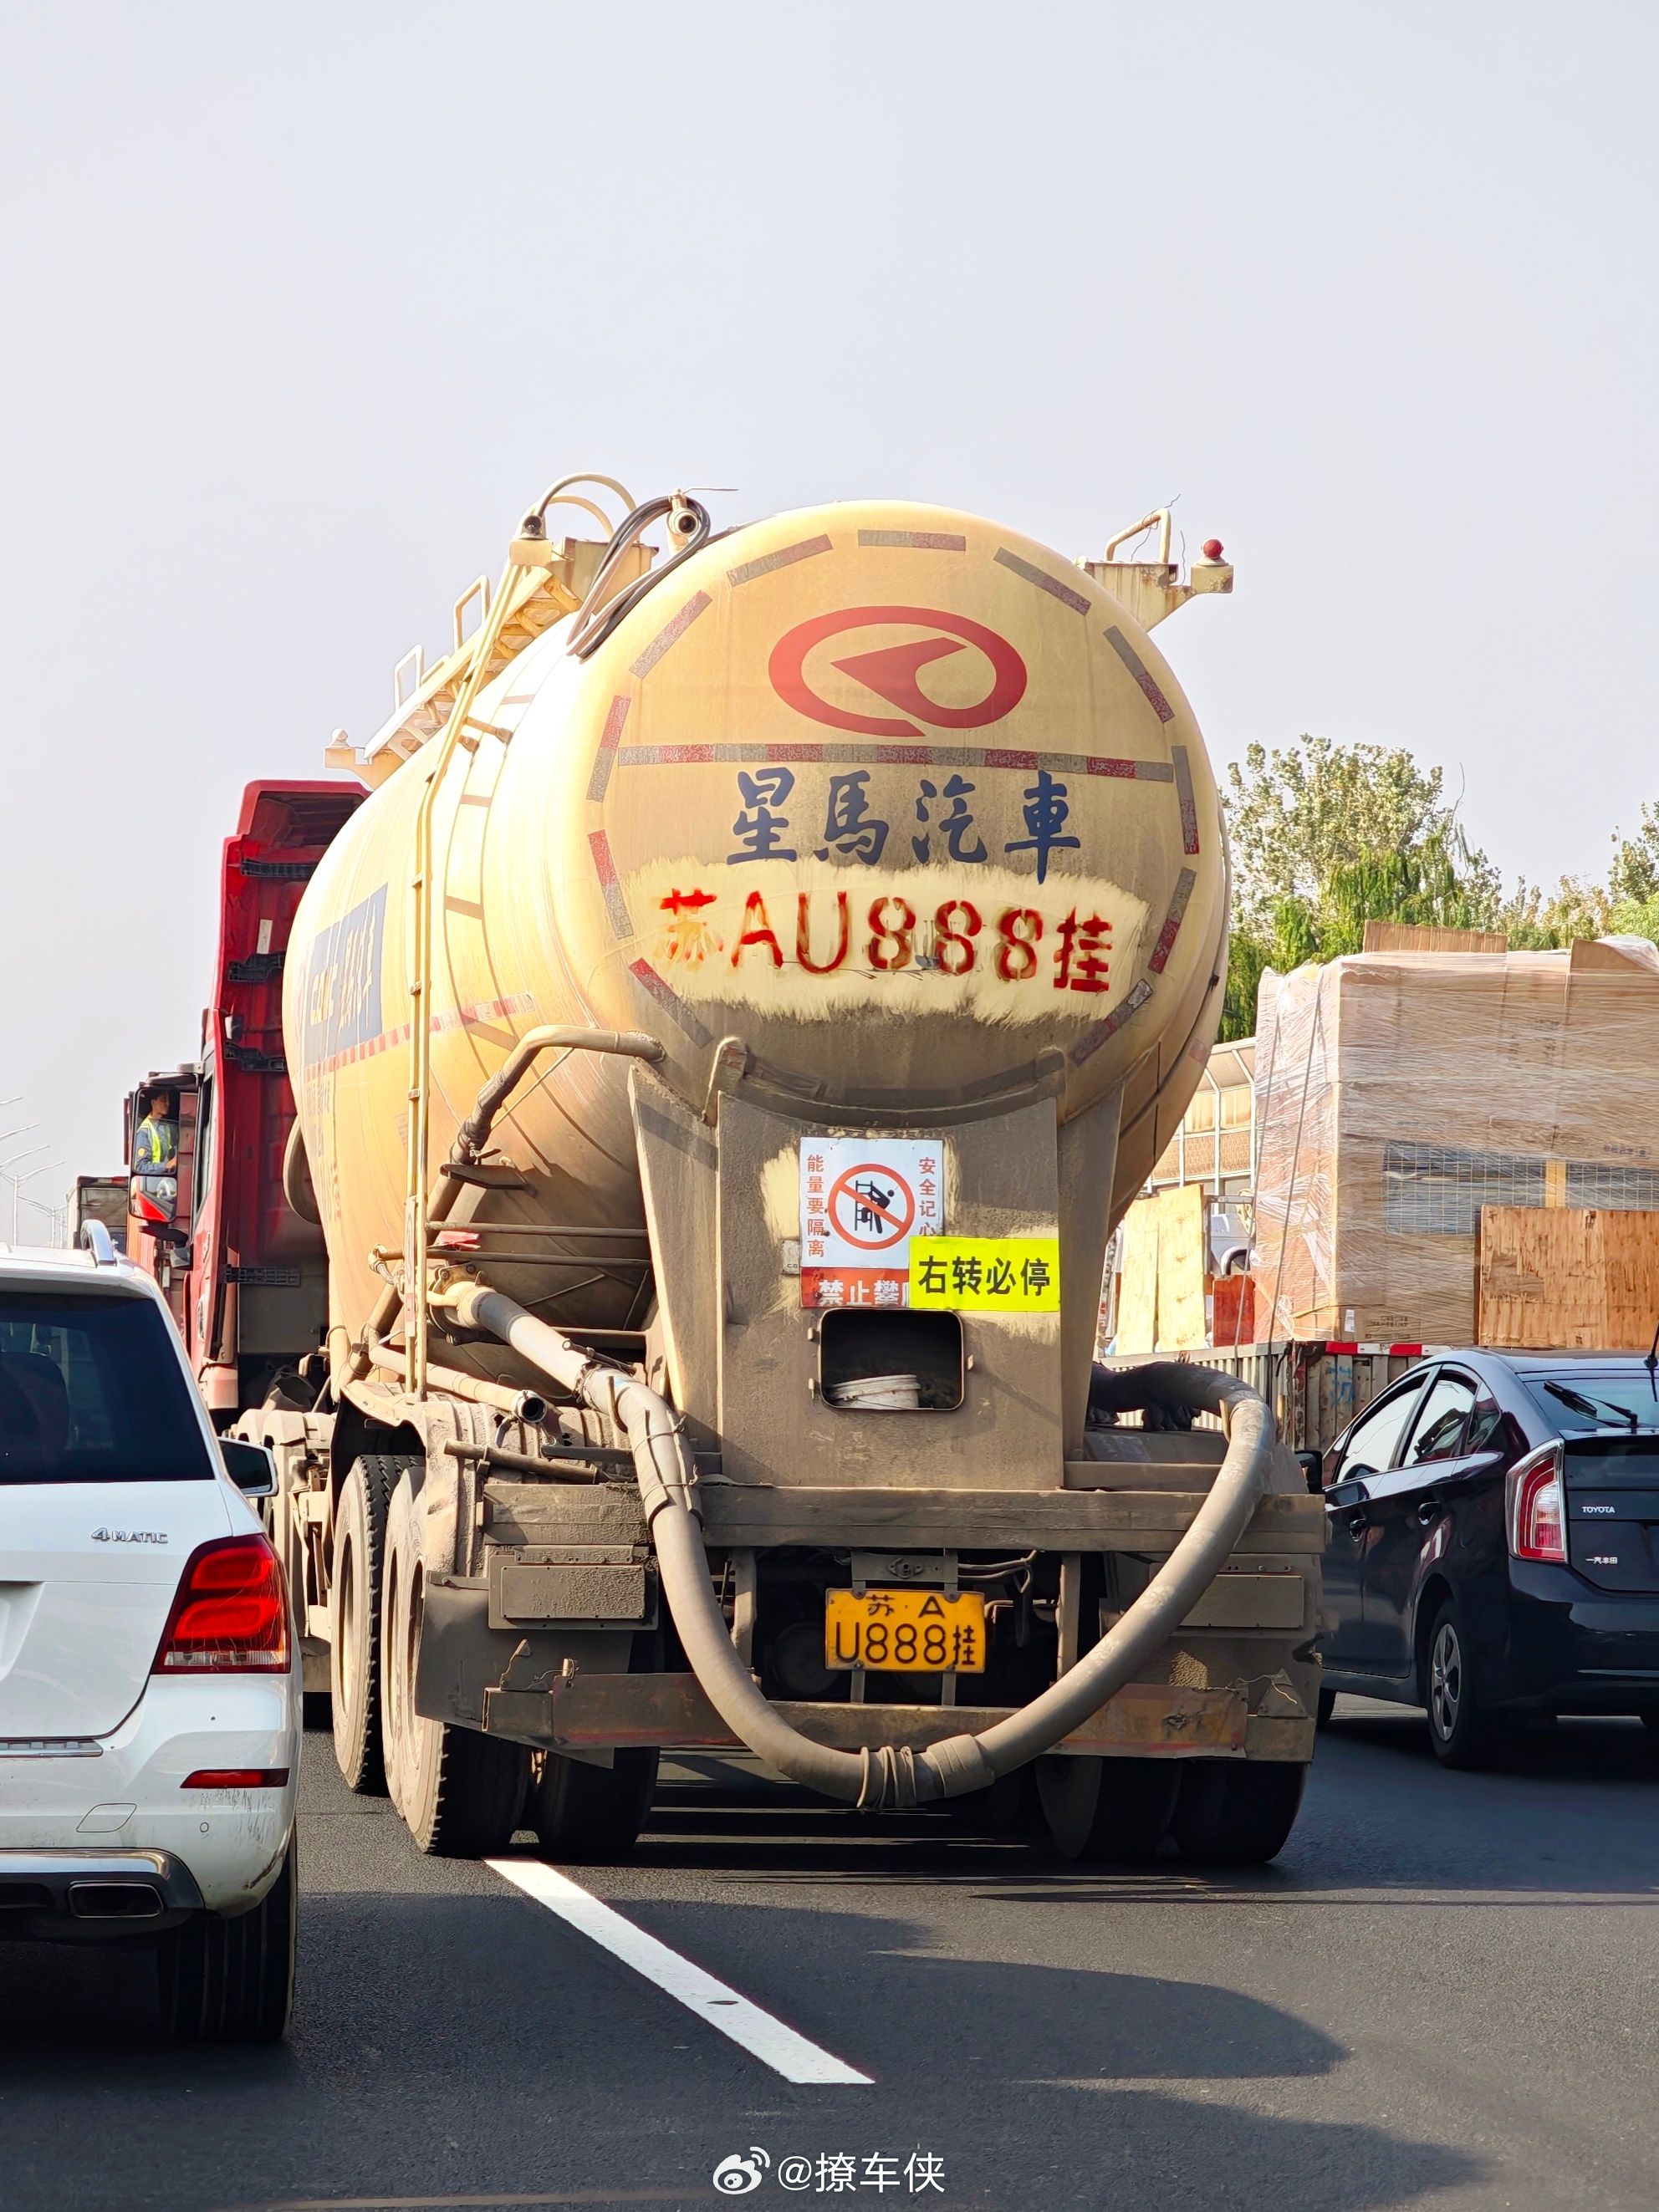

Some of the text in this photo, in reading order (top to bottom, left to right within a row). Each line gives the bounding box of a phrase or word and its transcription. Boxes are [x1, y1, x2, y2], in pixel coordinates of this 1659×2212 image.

[727, 767, 1080, 884] 星馬汽車
[806, 1154, 825, 1258] 能量要隔离
[818, 1279, 910, 1307] 禁止攀
[918, 1256, 1051, 1297] 右转必停
[835, 1621, 976, 1666] U888挂
